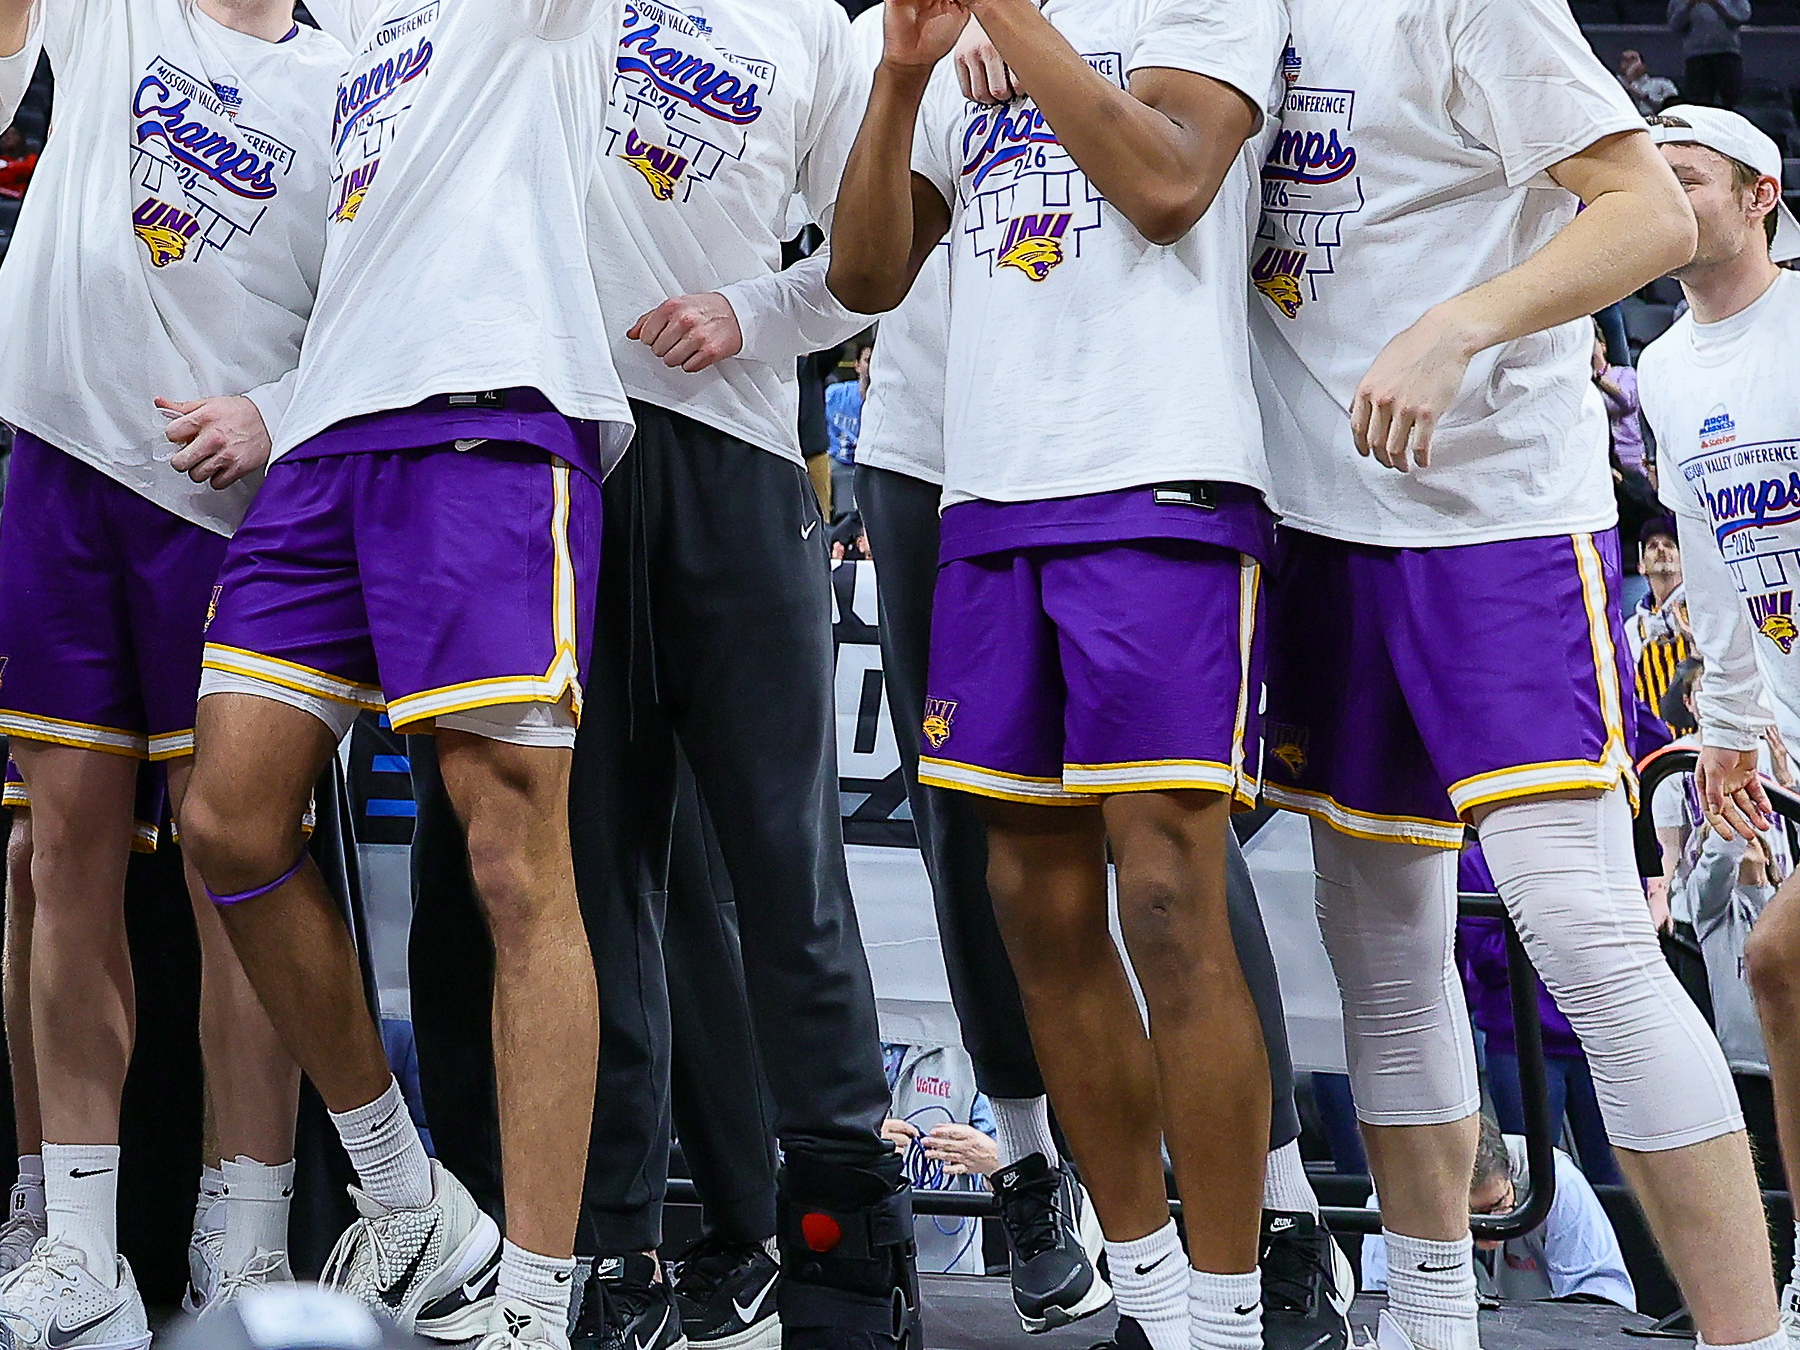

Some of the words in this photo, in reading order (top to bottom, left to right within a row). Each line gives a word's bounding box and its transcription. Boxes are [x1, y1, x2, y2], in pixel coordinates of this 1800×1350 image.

[377, 9, 433, 46] CONFERENCE
[157, 65, 196, 100] MISSOURI
[1286, 94, 1346, 114] CONFERENCE
[133, 75, 277, 199] Champs
[625, 128, 689, 181] UNI
[133, 197, 200, 240] UNI
[1252, 246, 1308, 279] UNI
[1705, 455, 1732, 473] VALLEY
[1734, 446, 1798, 467] CONFERENCE
[1746, 590, 1794, 630] UNI
